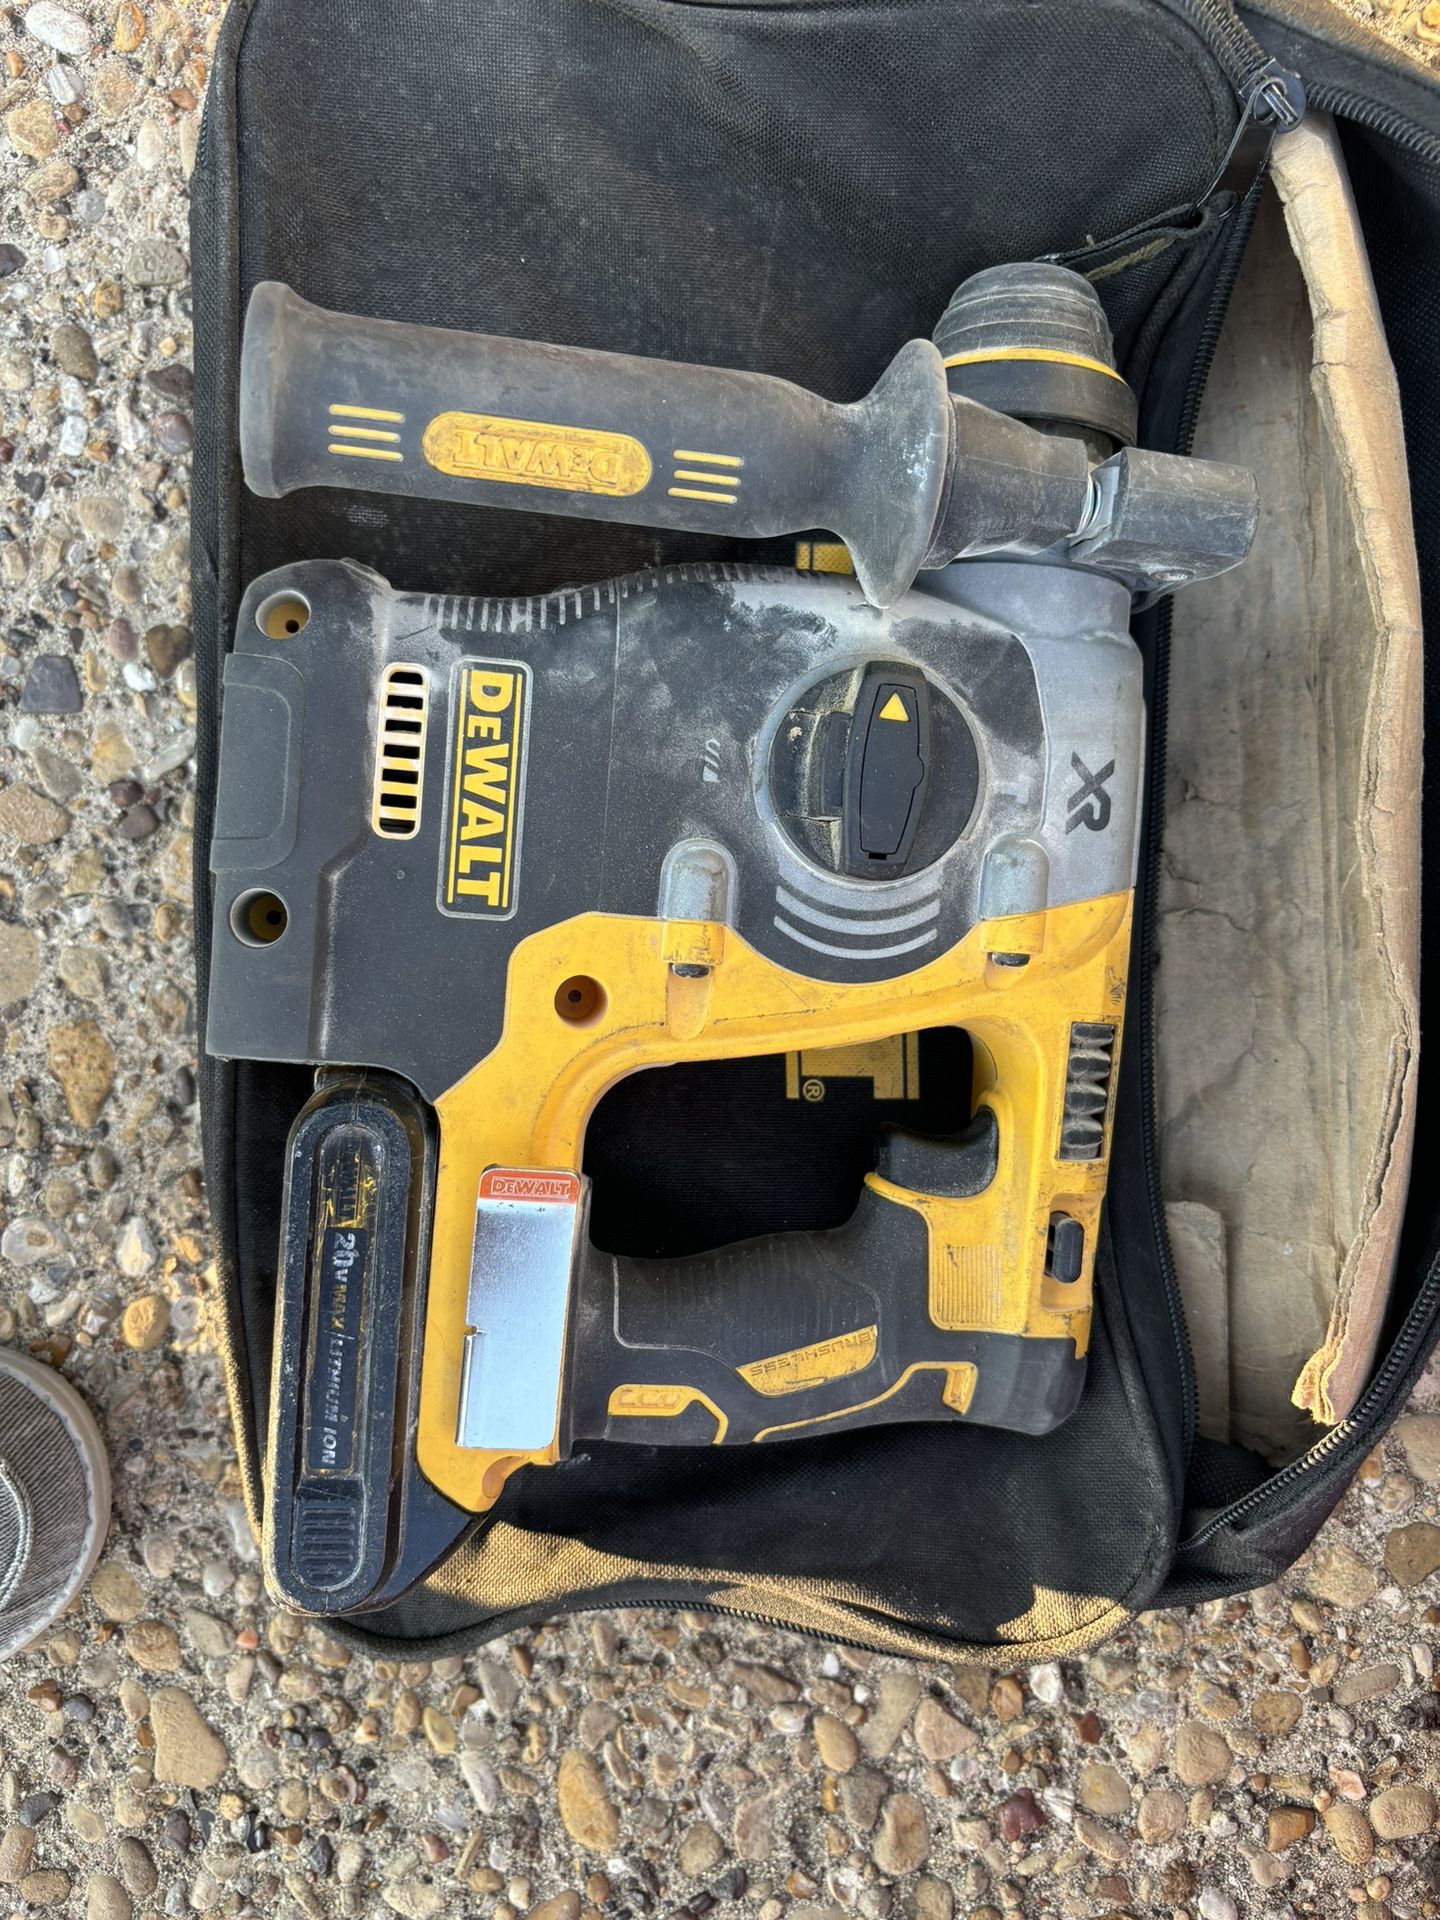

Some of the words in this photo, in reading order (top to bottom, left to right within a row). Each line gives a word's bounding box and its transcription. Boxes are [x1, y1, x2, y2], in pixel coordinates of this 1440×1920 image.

[453, 432, 621, 486] DEWALT
[457, 670, 514, 907] DEWALT
[1065, 751, 1115, 835] XR
[492, 1177, 571, 1198] DEWALT
[750, 1331, 871, 1377] BRUSHLESS
[322, 1427, 337, 1464] ION
